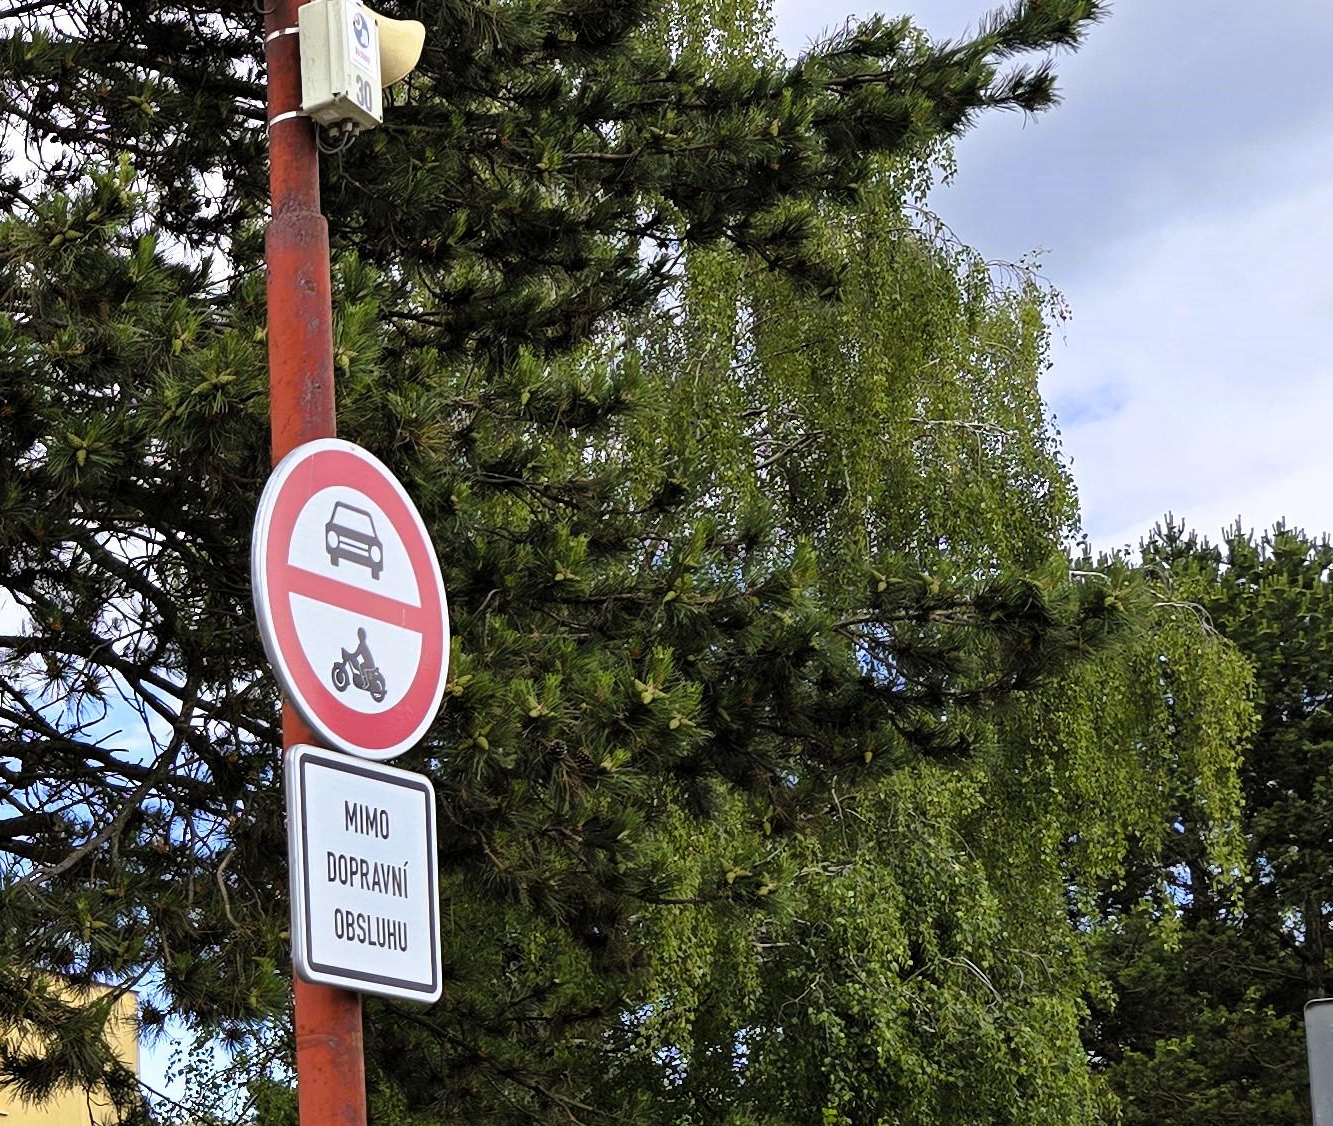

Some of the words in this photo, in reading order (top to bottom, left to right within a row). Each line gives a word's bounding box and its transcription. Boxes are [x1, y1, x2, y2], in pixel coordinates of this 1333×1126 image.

[355, 74, 373, 112] 30
[344, 800, 390, 840] MIMO
[326, 851, 409, 899] DOPRAVNÍ
[334, 908, 408, 952] OBSLUHU
